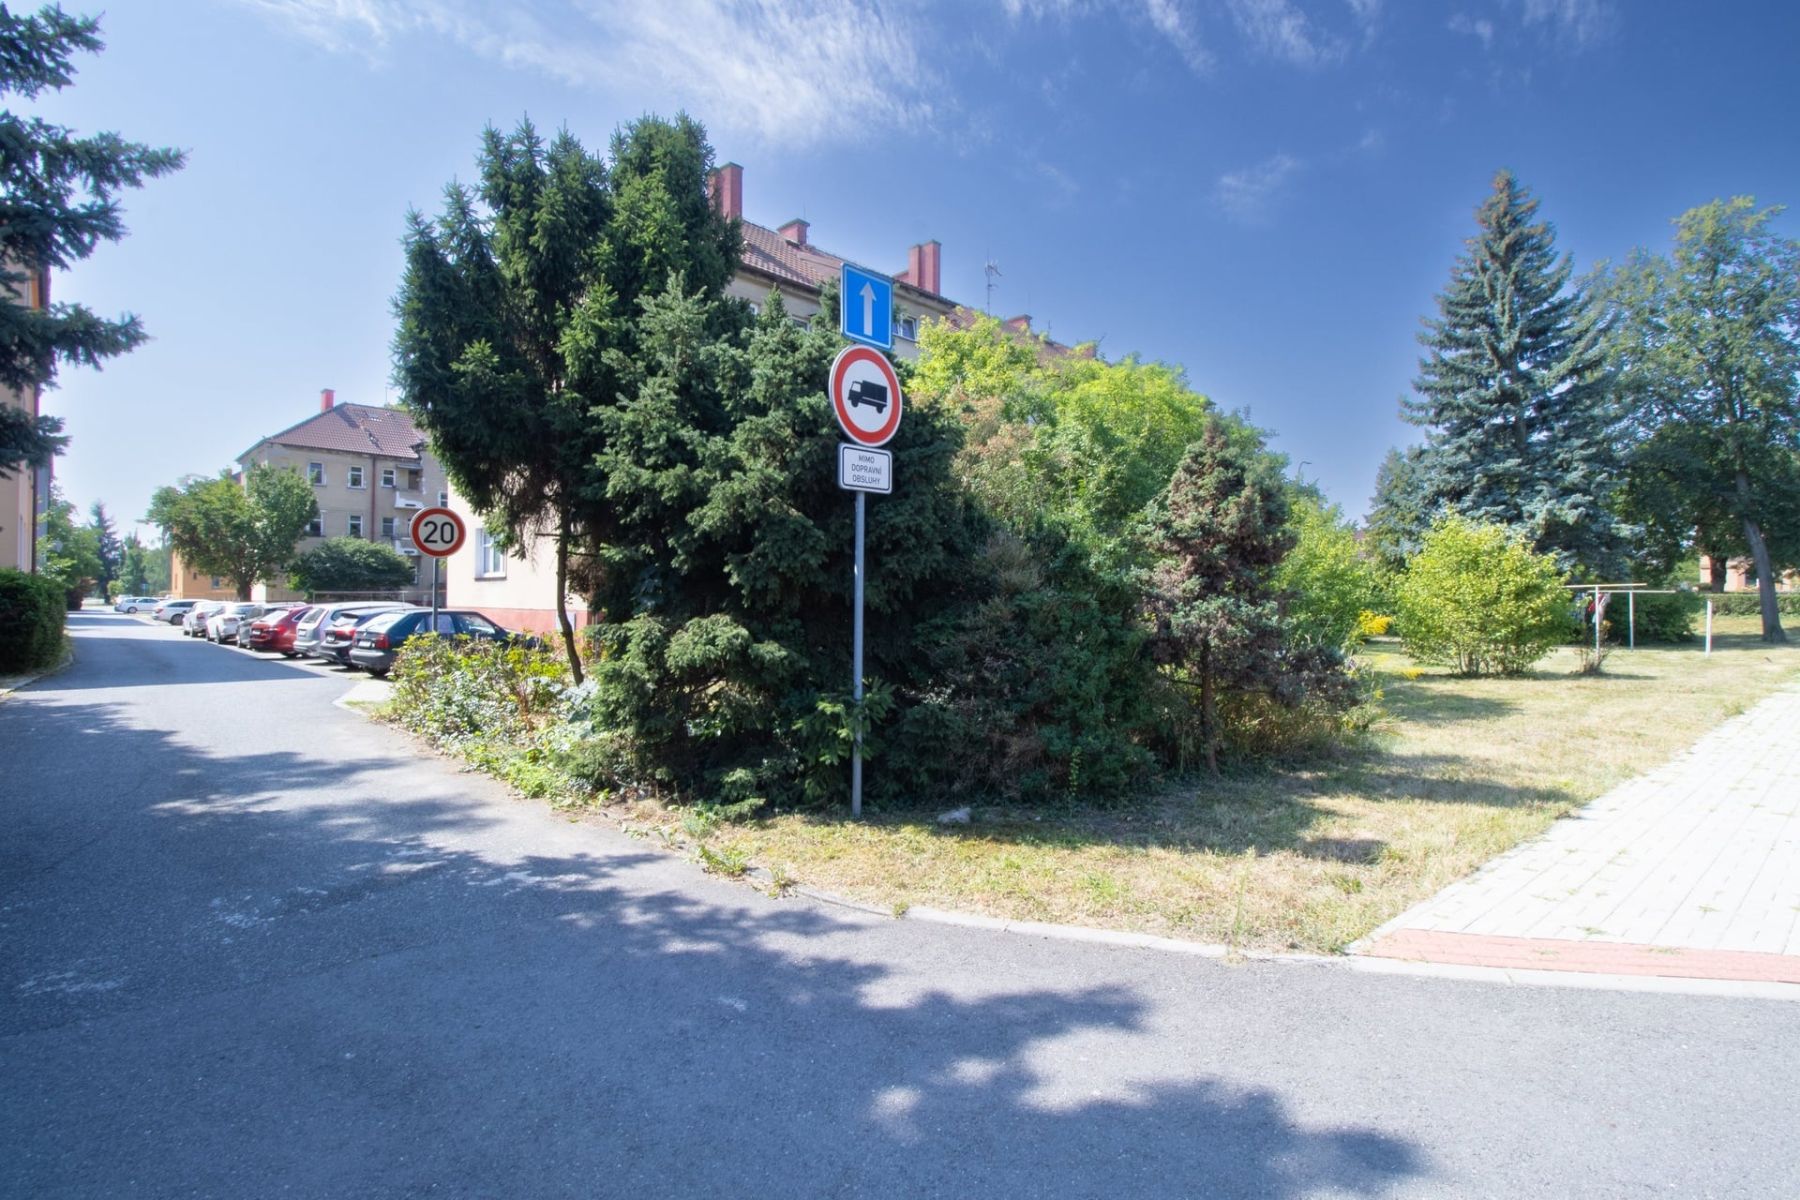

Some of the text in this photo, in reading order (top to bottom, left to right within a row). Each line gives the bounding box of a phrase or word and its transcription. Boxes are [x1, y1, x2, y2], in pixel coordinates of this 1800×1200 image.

[858, 455, 875, 464] MIMO
[853, 475, 880, 486] OBSLUHY
[423, 520, 455, 544] 20
